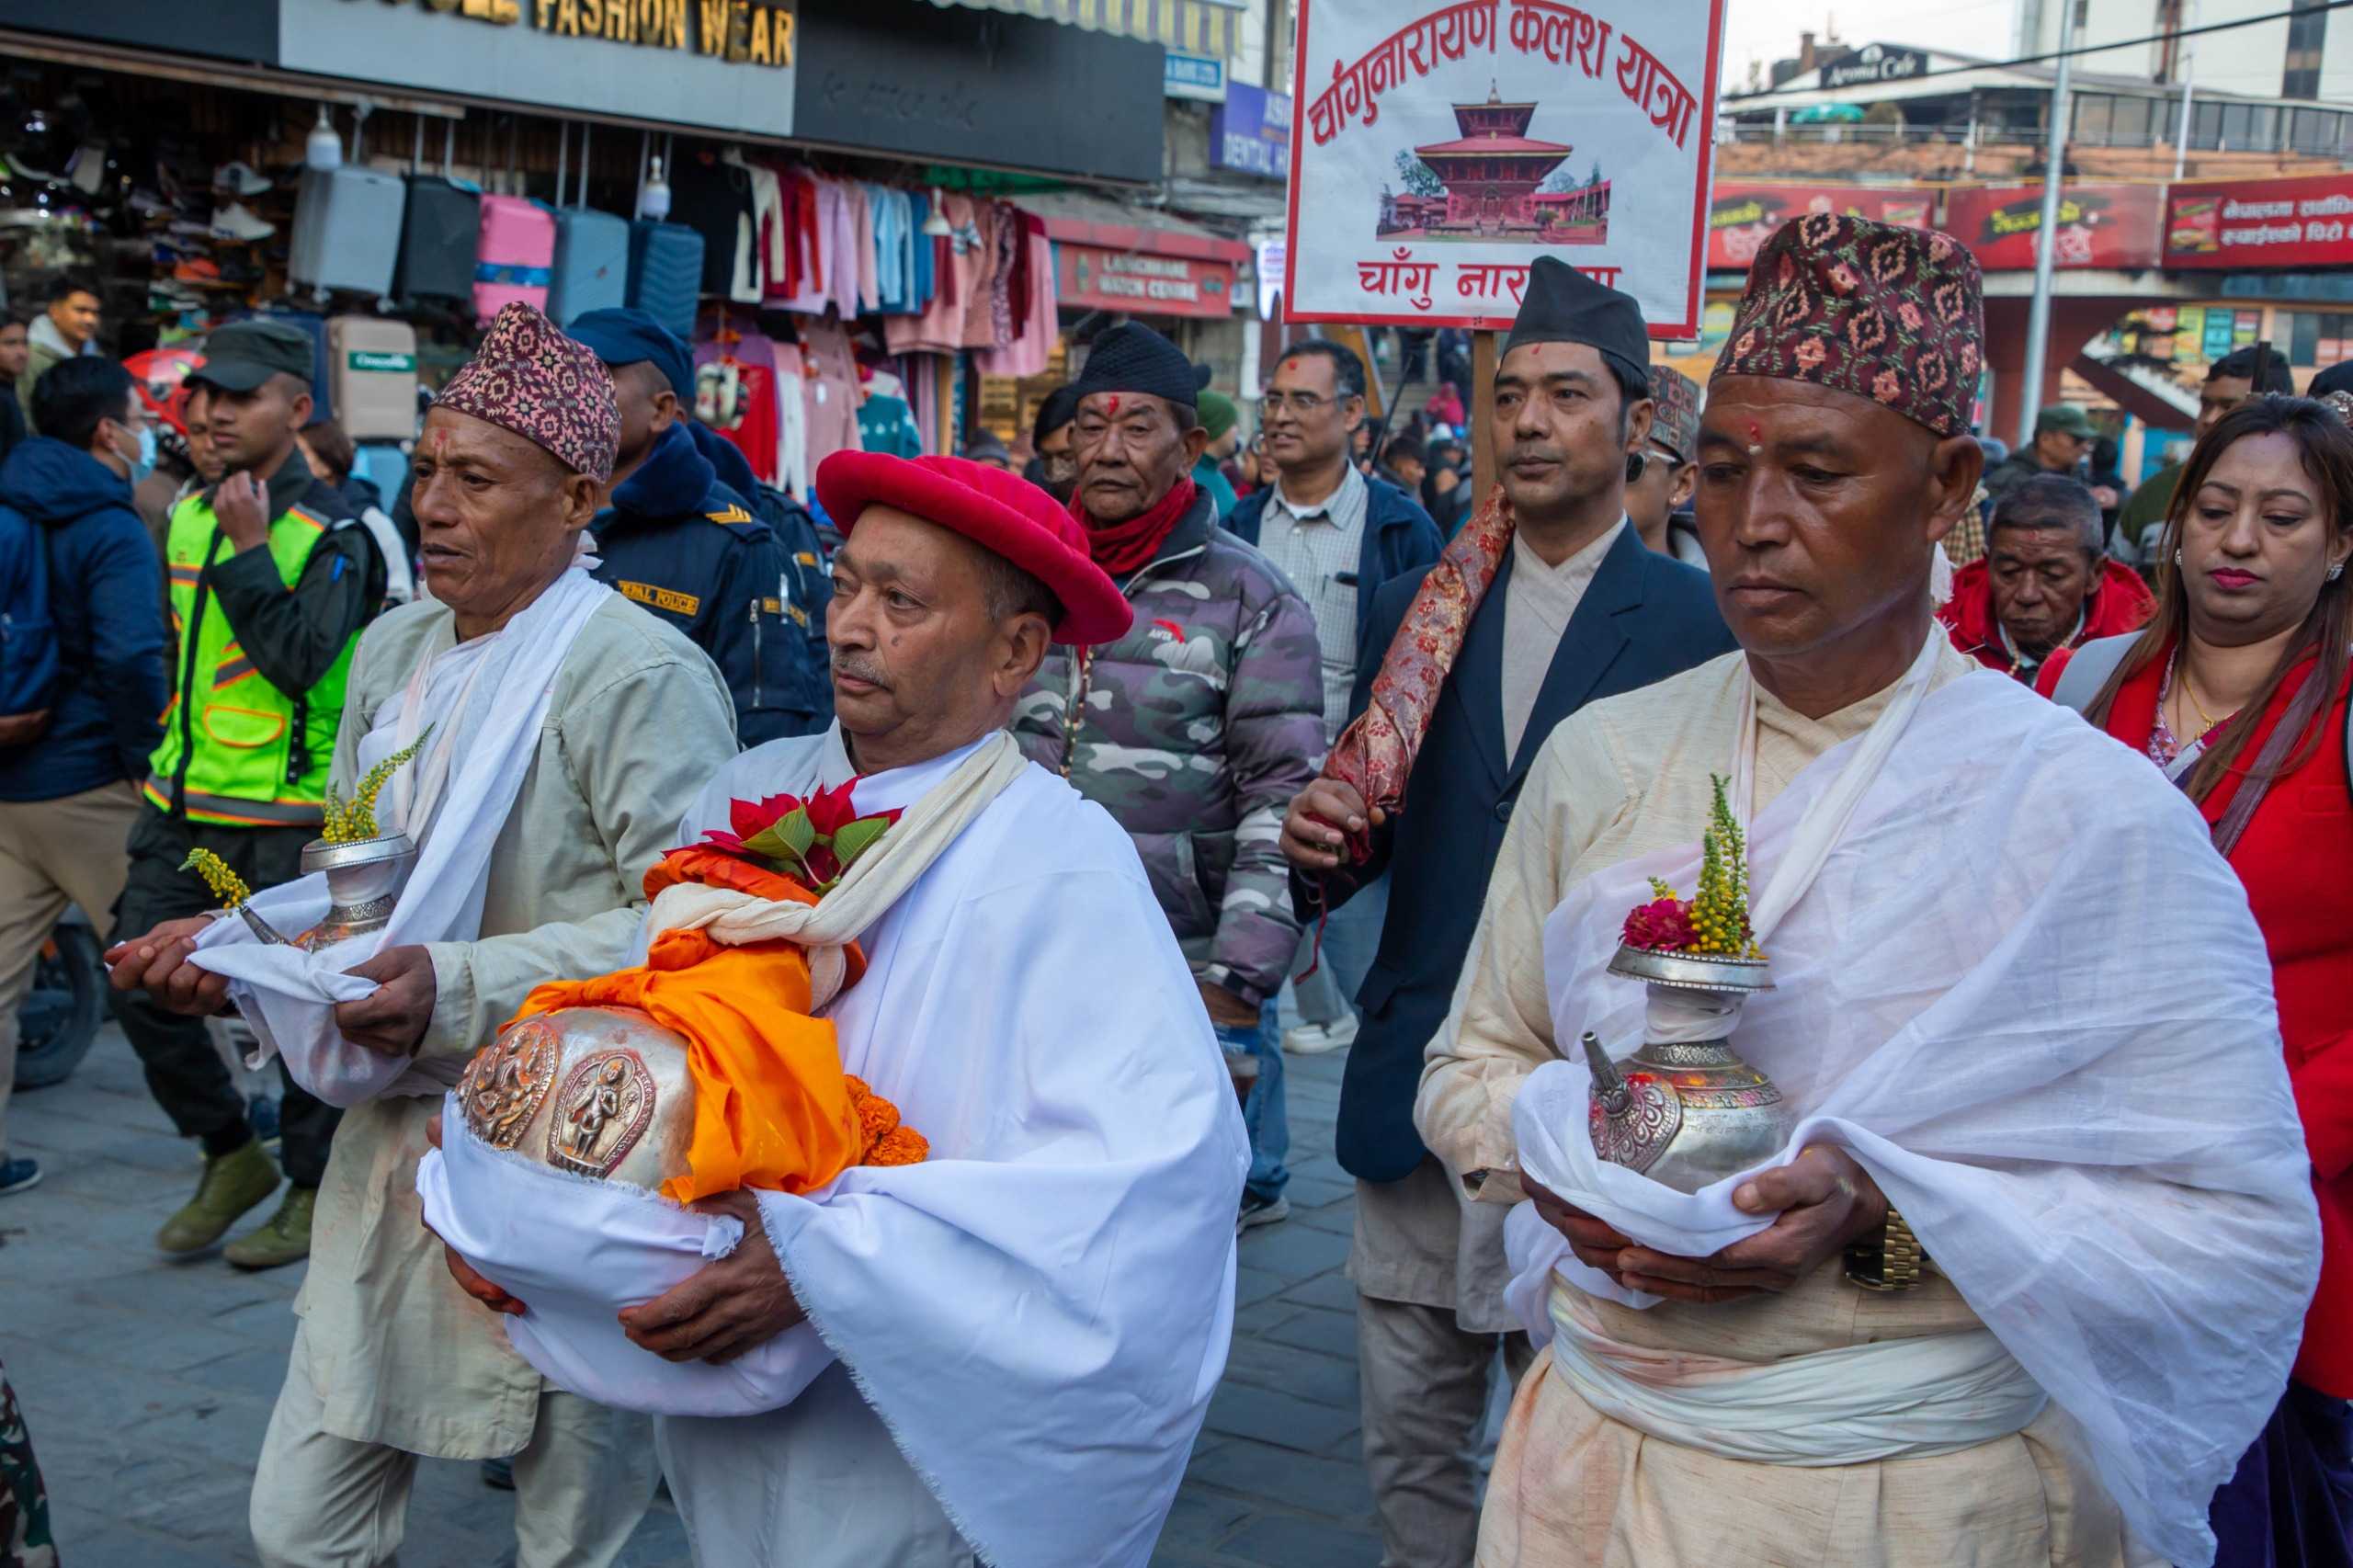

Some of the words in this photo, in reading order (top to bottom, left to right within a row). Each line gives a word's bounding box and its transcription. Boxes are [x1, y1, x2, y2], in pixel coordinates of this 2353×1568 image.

[700, 0, 794, 65] WEAR
[1307, 0, 1500, 145] चांगुनारायण
[1508, 0, 1612, 77] कलश
[1616, 33, 1699, 150] यात्रा
[1827, 66, 1879, 86] Aroma
[1357, 246, 1439, 311] चाँगु
[655, 589, 697, 612] POLICE
